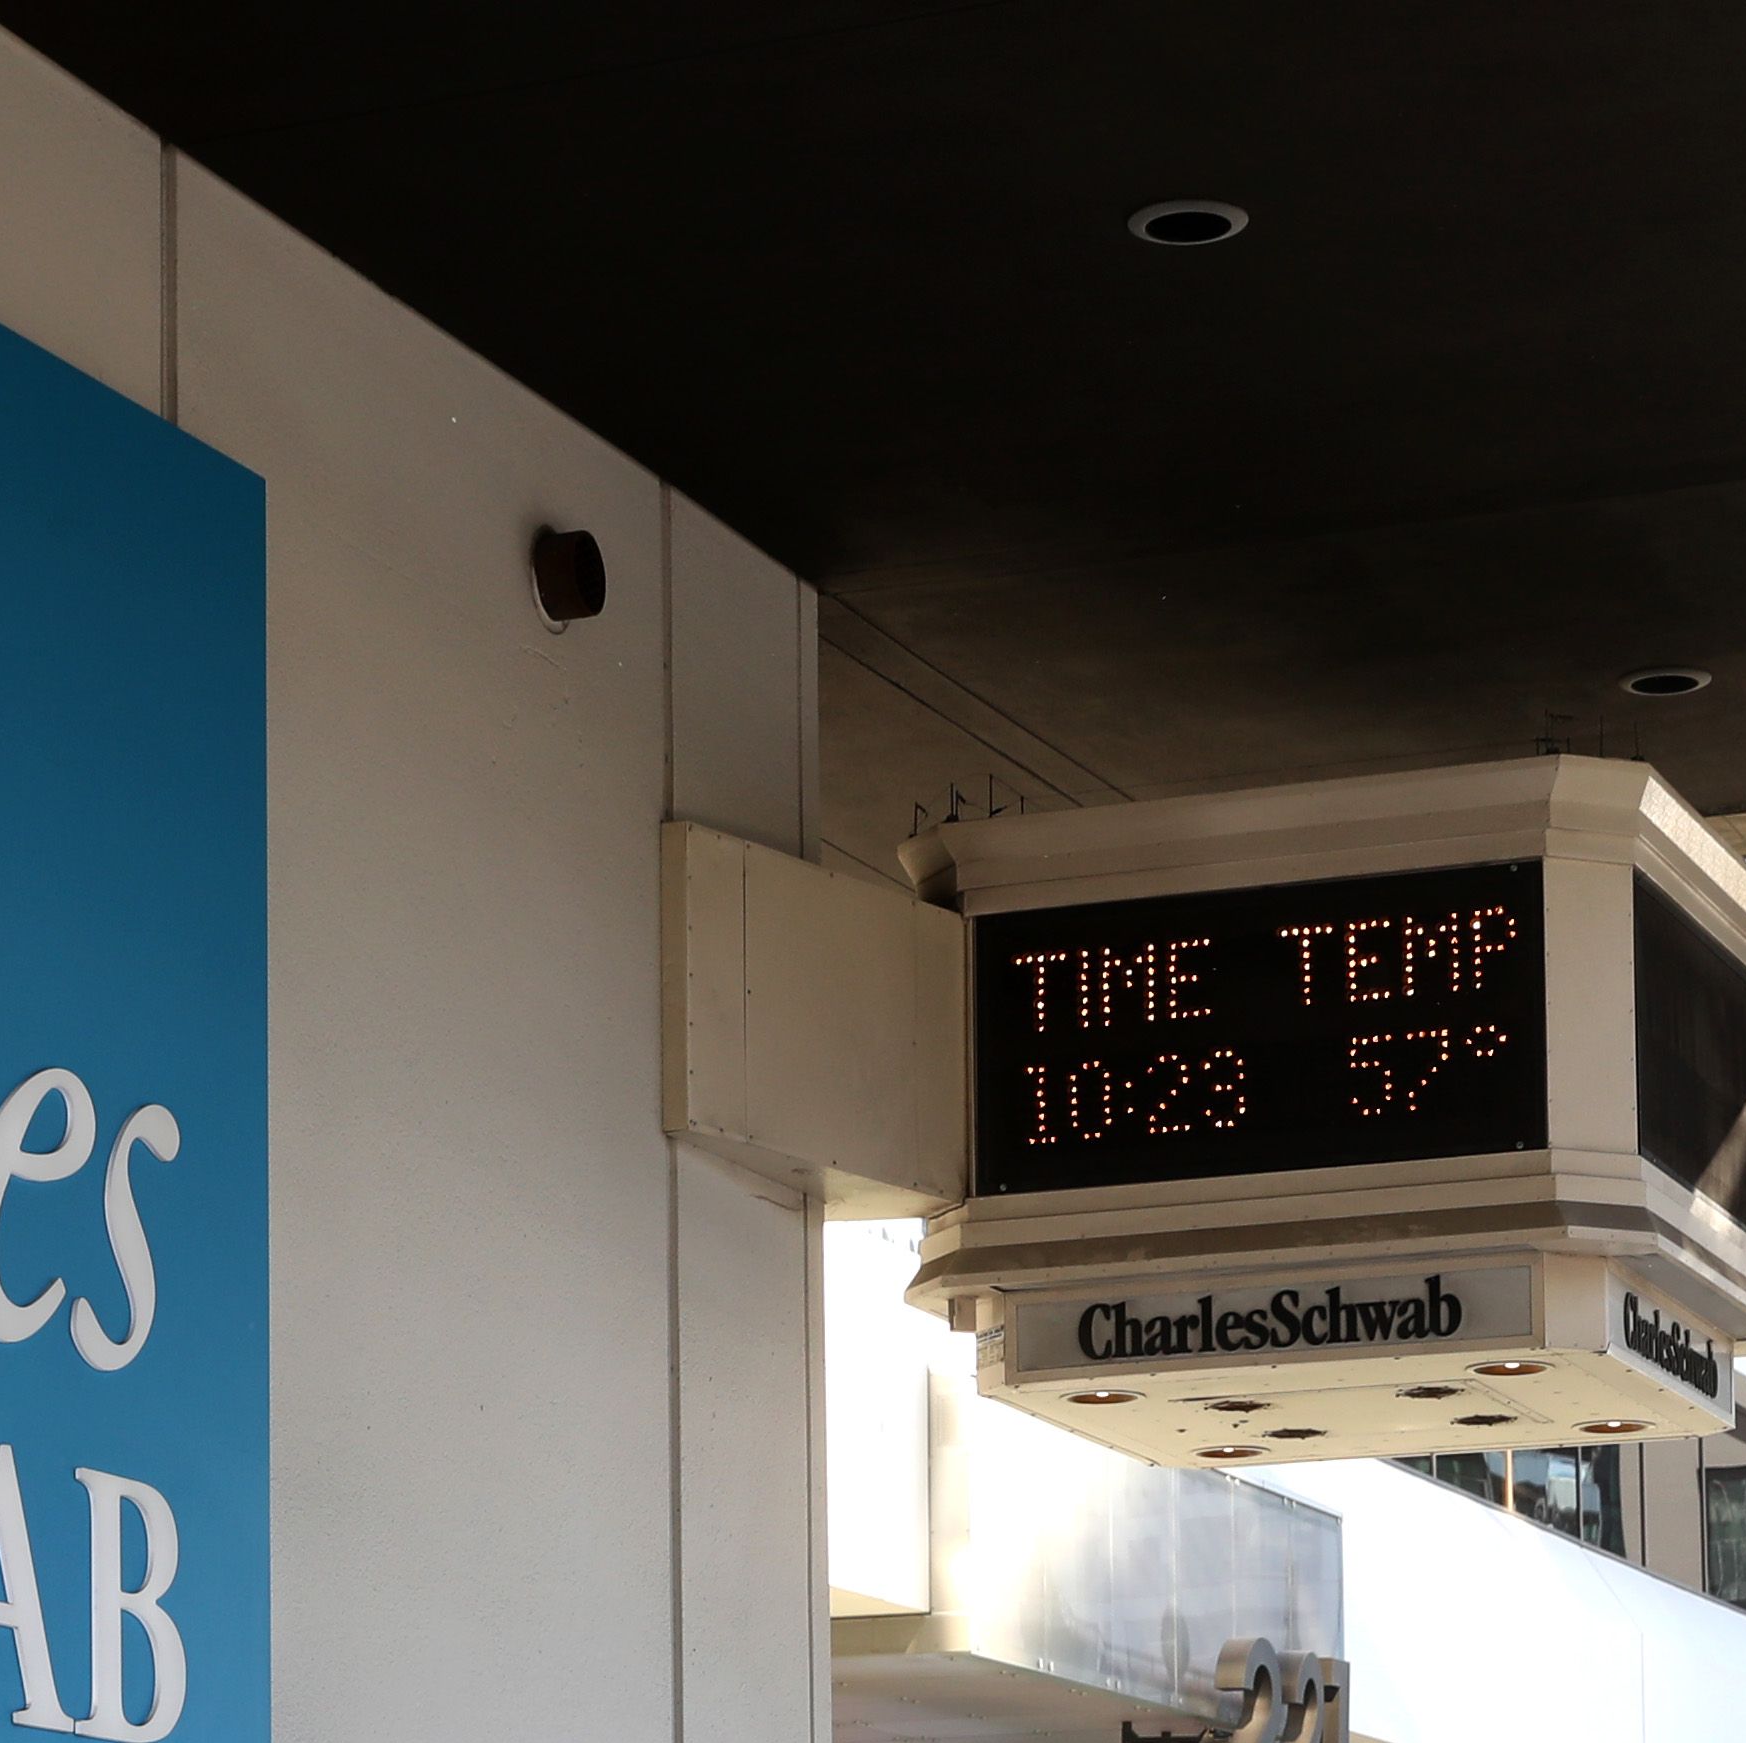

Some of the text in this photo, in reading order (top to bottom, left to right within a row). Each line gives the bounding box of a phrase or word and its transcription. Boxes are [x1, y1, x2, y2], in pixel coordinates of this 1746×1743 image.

[1011, 906, 1516, 1032] TIME TEMP
[1026, 1049, 1247, 1145] 10:23
[1077, 1274, 1463, 1361] CharlesSchwab
